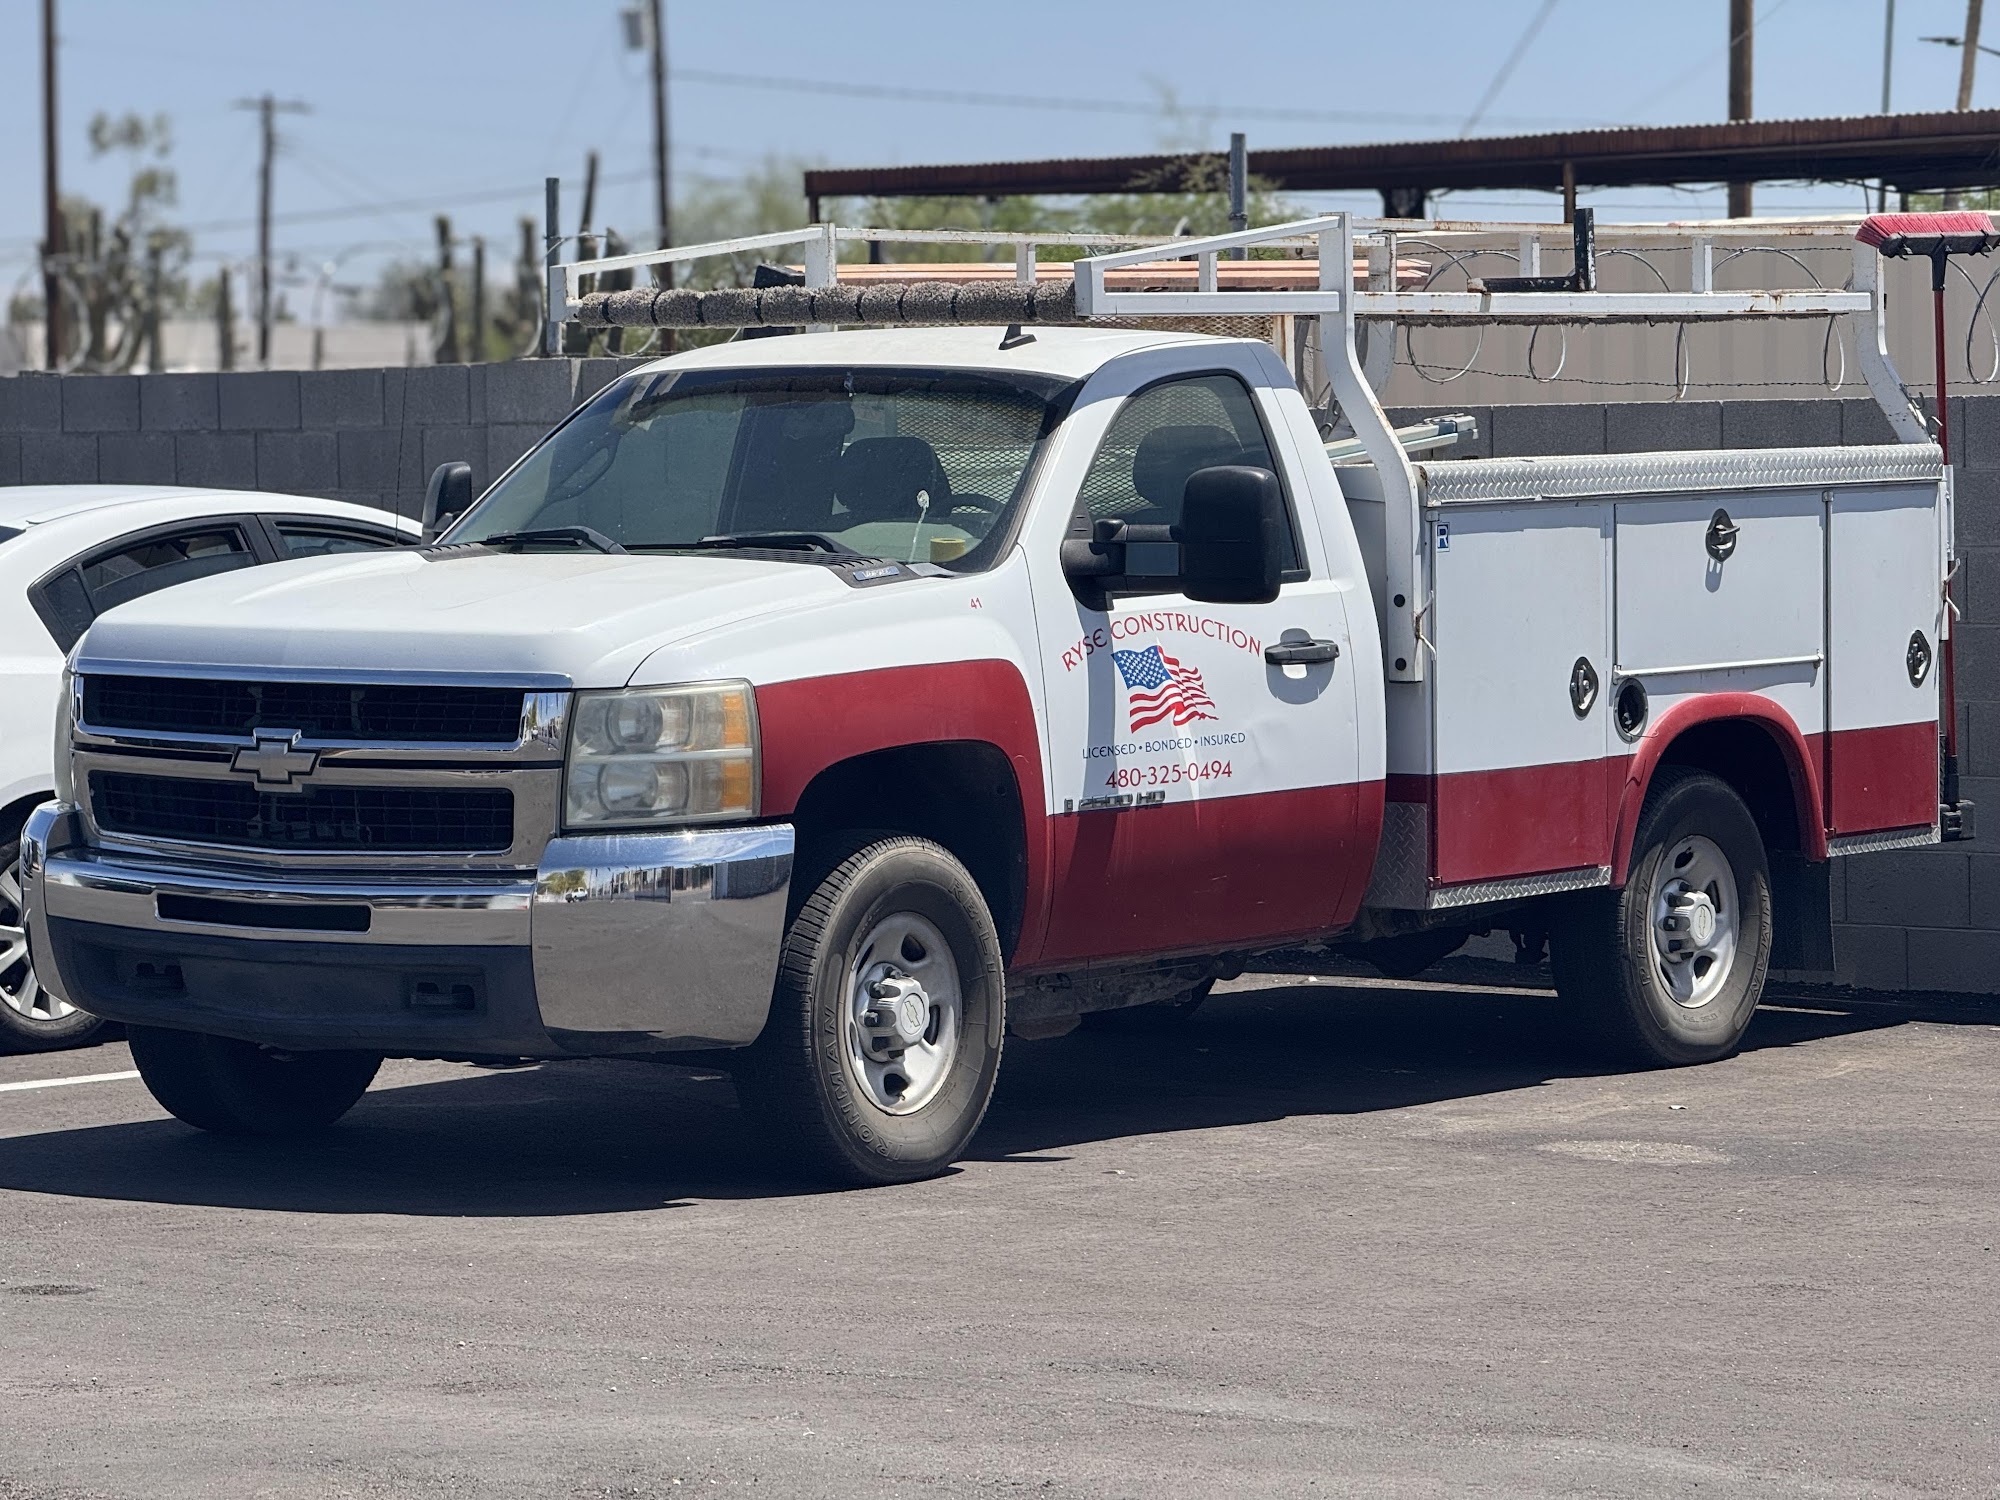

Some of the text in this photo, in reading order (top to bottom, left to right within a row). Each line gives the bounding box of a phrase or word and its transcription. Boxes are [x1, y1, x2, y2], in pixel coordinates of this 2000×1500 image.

[970, 597, 983, 610] 41
[1062, 612, 1261, 672] RYSE CONSTRUCTION
[1082, 732, 1246, 759] LICENSED BONDED INSURED
[1105, 760, 1232, 789] 480-325-0494
[1136, 790, 1166, 805] HD
[823, 1006, 904, 1161] IRONMAN
